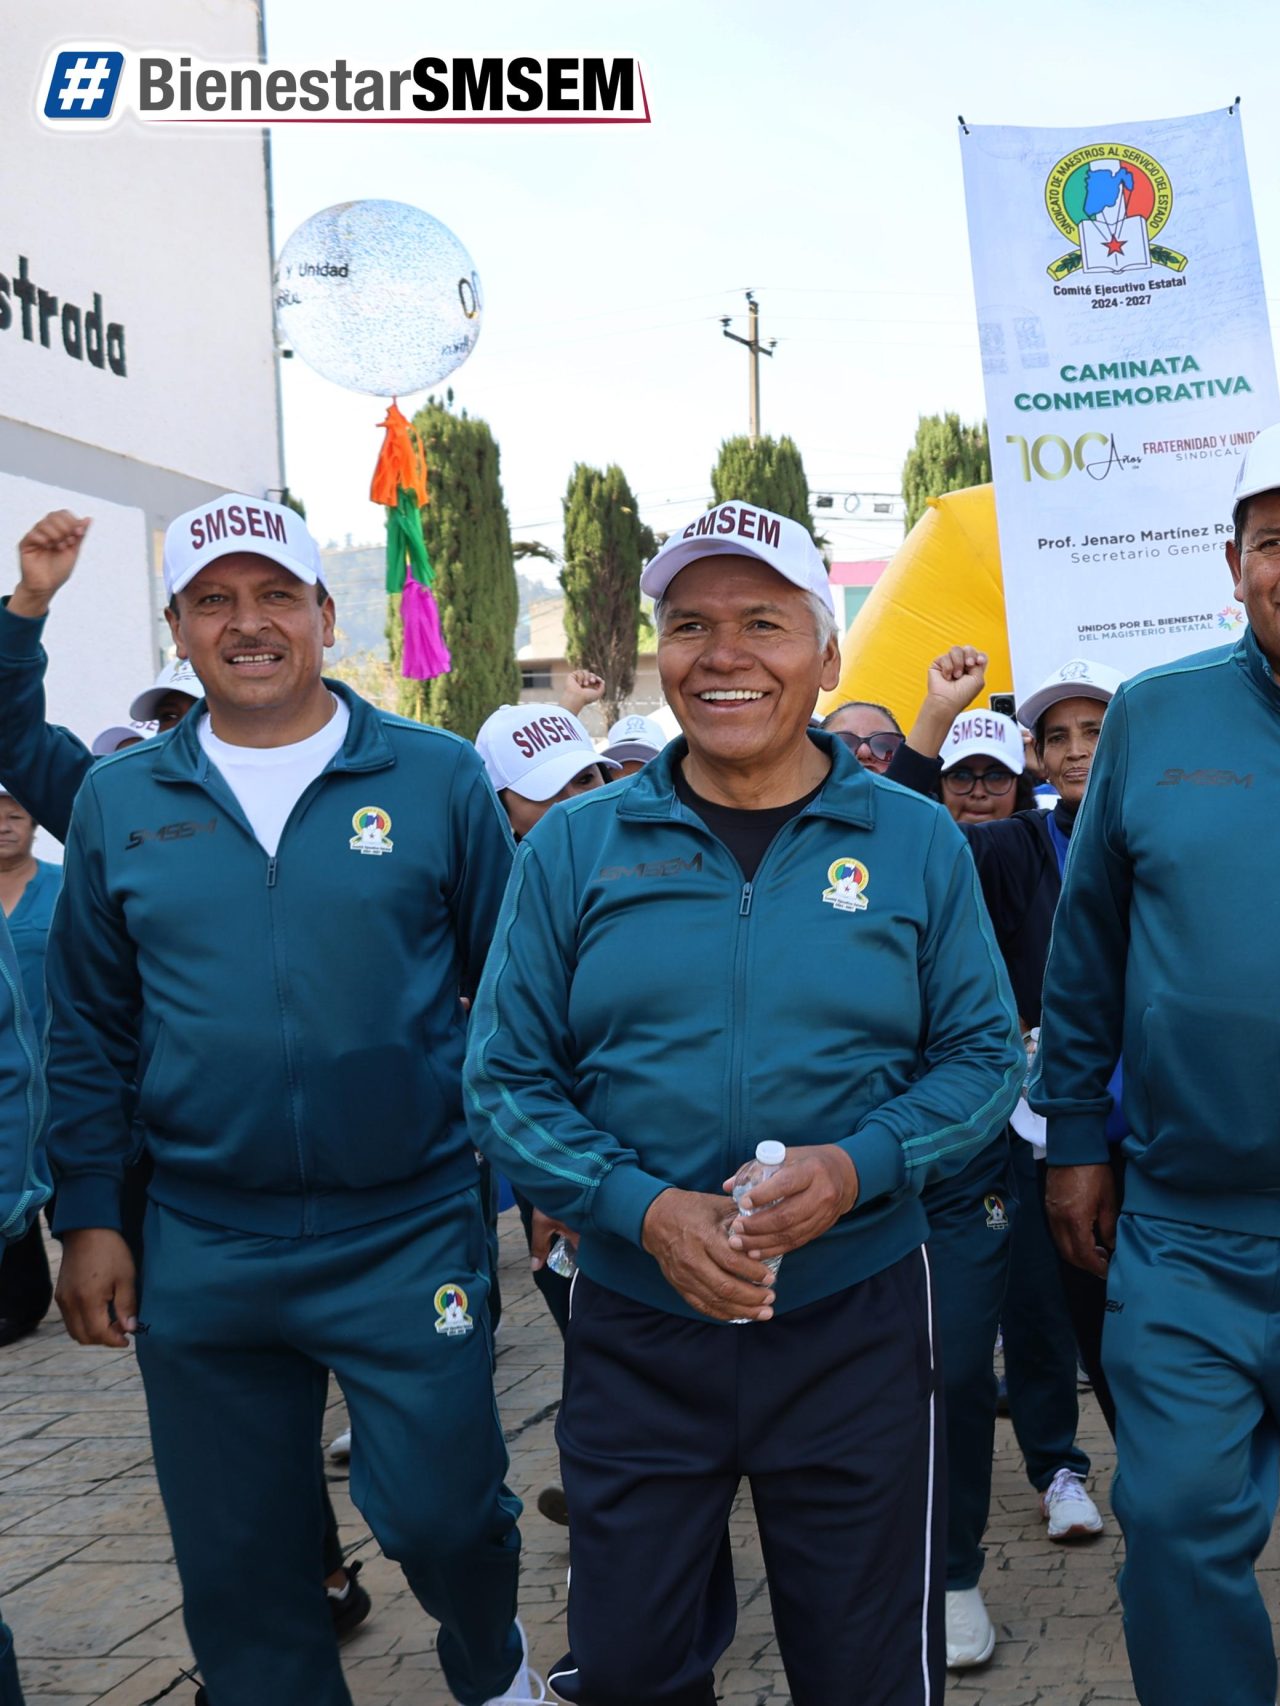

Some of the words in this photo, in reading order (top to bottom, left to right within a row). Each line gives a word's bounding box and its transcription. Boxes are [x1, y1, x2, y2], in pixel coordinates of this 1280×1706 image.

[1057, 147, 1105, 176] MAESTROS
[1108, 147, 1121, 156] AL
[1122, 149, 1160, 177] SERVICIO
[1050, 175, 1062, 188] DE
[1154, 176, 1168, 193] DEL
[1049, 189, 1075, 235] SINDICATO
[1149, 194, 1169, 229] ESTADO
[298, 261, 349, 278] Unidad
[1053, 284, 1092, 297] Comité
[1095, 281, 1145, 297] Ejecutivo
[1148, 276, 1187, 291] Estatal
[1091, 298, 1118, 310] 2024
[1126, 295, 1151, 307] 2027
[1059, 354, 1200, 383] CAMINATA
[1014, 375, 1252, 411] CONMEMORATIVA
[1142, 435, 1217, 455] FRATERNIDAD
[1219, 434, 1227, 447] Y
[1230, 430, 1260, 446] UNID
[1175, 447, 1241, 462] SINDICAL
[190, 505, 288, 550] SMSEM
[1037, 536, 1077, 551] Prof.
[1081, 532, 1136, 548] Jenaro
[1141, 526, 1210, 542] Martínez
[1214, 523, 1235, 535] Re
[1071, 546, 1161, 564] Secretario
[1168, 541, 1226, 556] Genera
[1077, 622, 1117, 634] UNIDOS
[1120, 620, 1142, 631] POR
[1144, 618, 1157, 628] EL
[1158, 613, 1214, 627] BIENESTAR
[1078, 632, 1094, 642] DEL
[1095, 627, 1166, 641] MAGISTERIO
[1169, 622, 1214, 634] ESTATAL
[512, 716, 583, 759] SMSEM
[952, 716, 1007, 745] SMSEM
[125, 817, 218, 851] SMSEM
